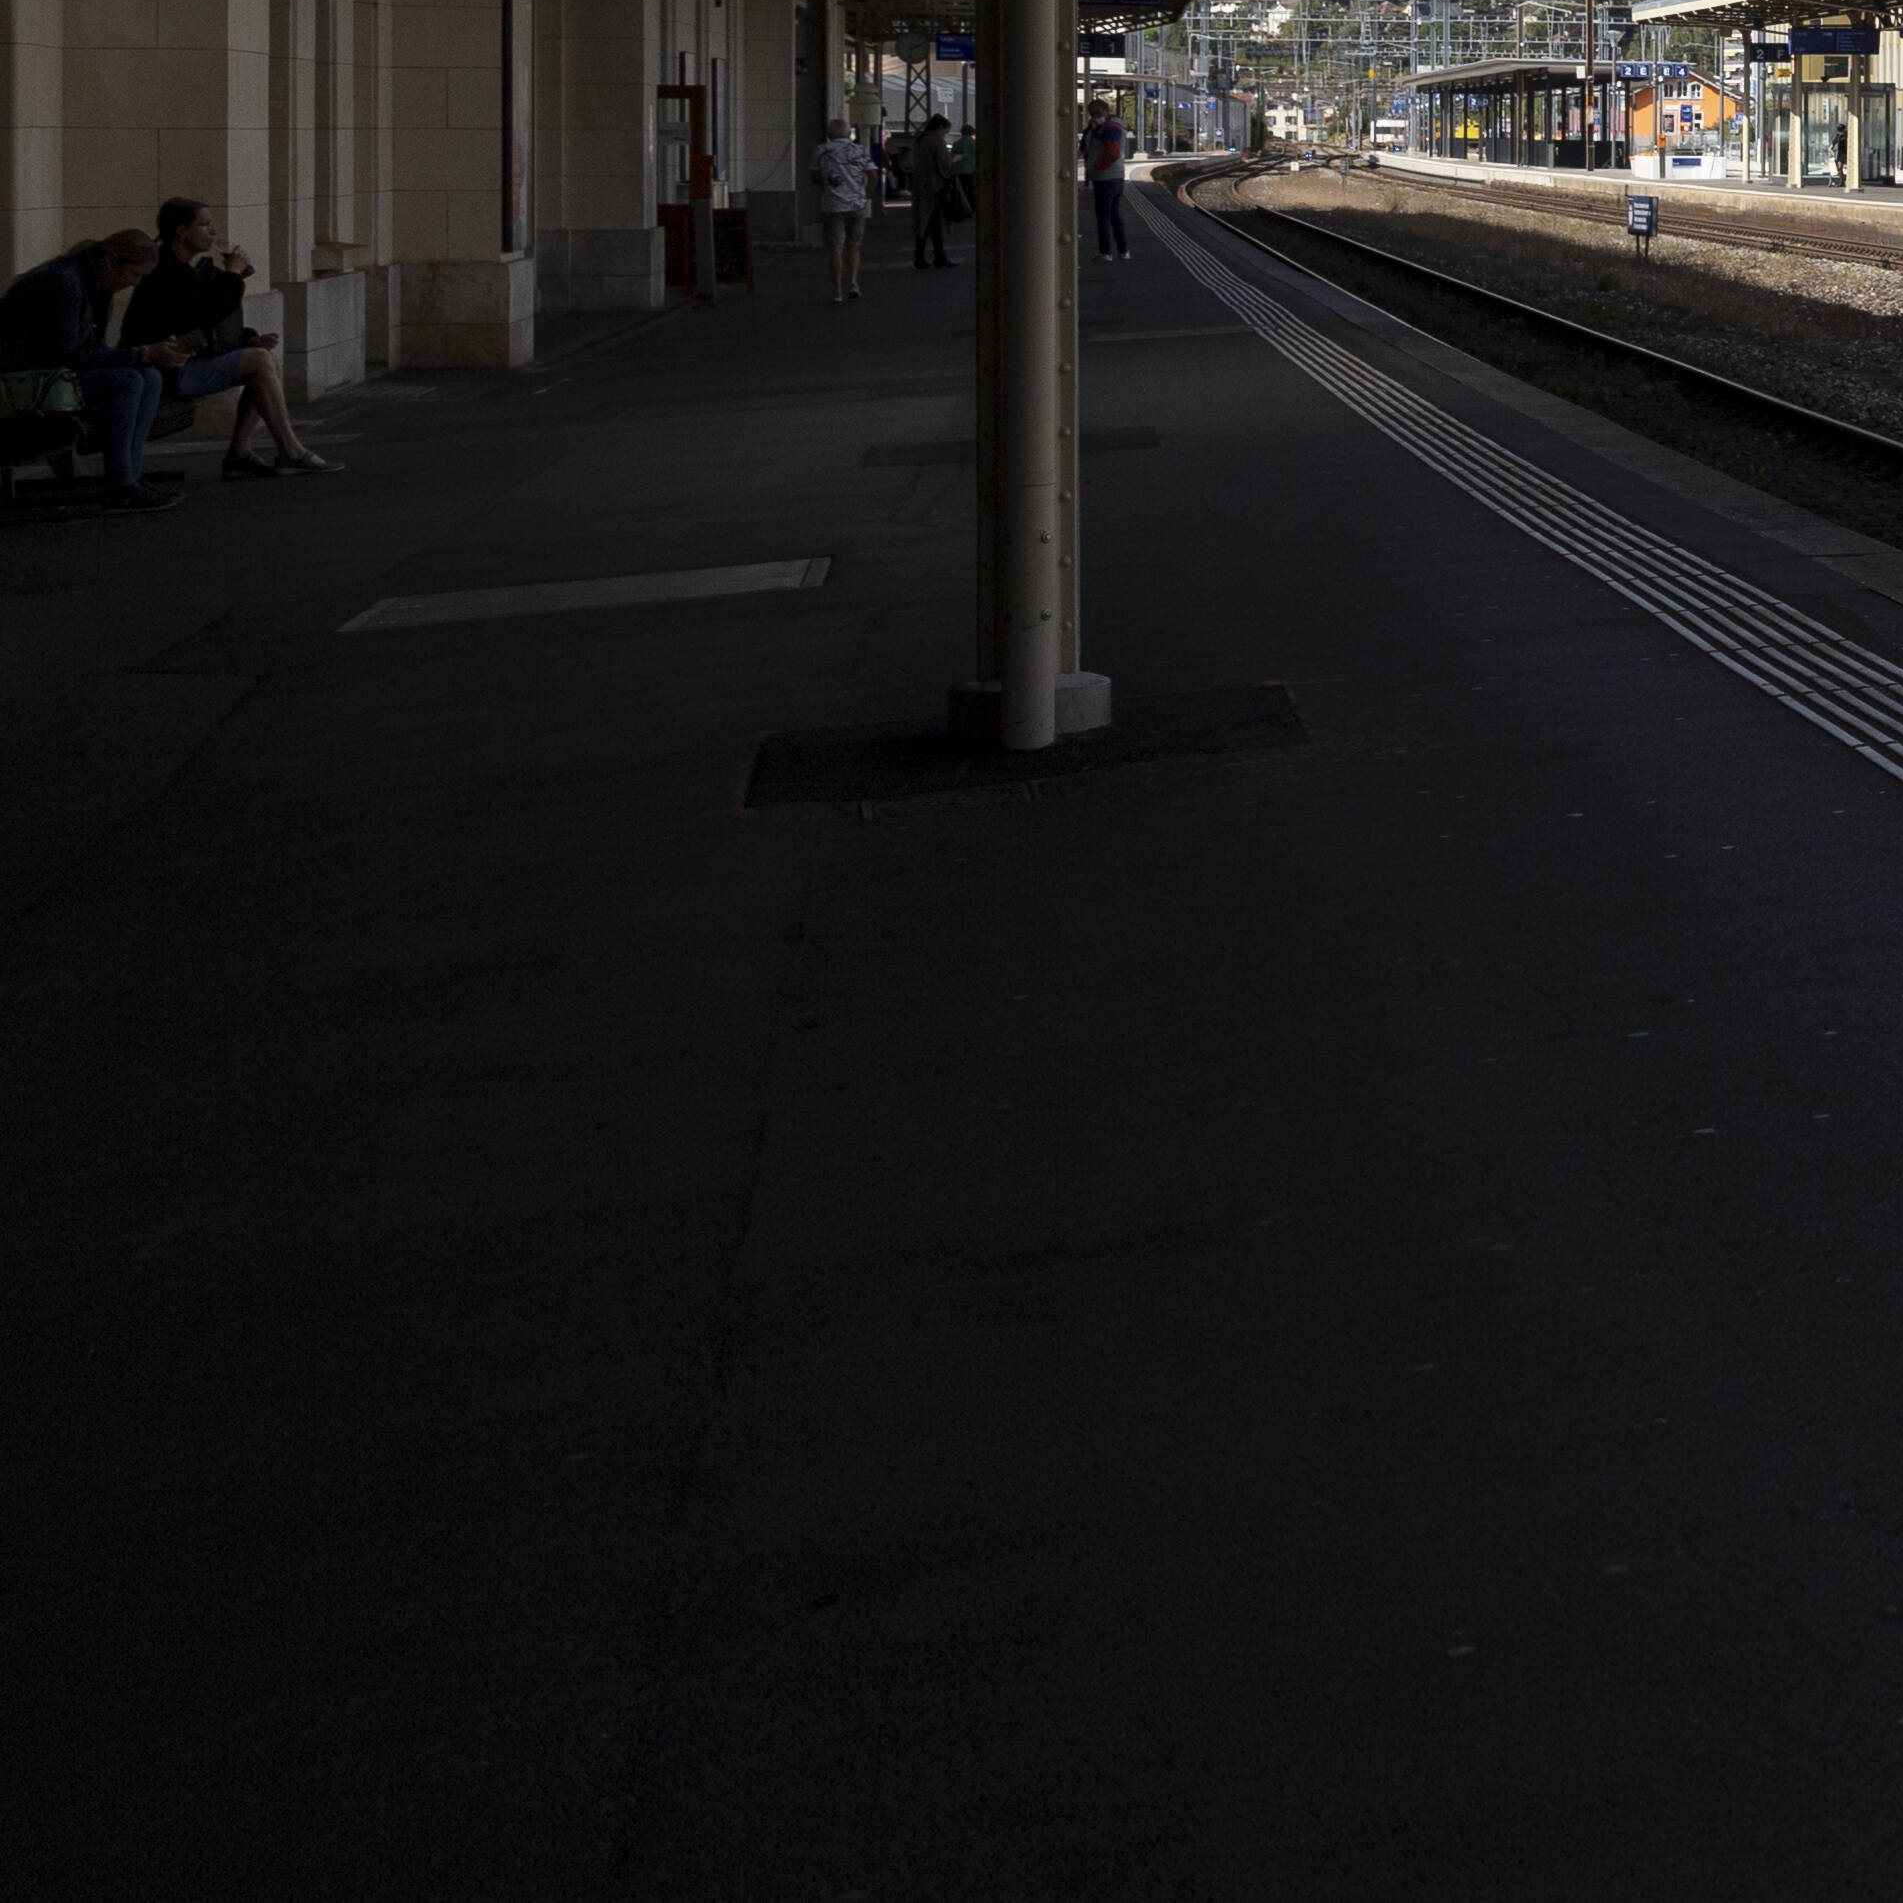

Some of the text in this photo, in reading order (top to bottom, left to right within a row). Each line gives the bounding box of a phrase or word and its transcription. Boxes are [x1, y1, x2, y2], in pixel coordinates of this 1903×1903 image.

[1756, 49, 1765, 60] 2
[1777, 49, 1785, 59] F
[1625, 67, 1632, 75] 2
[1678, 67, 1685, 76] 4
